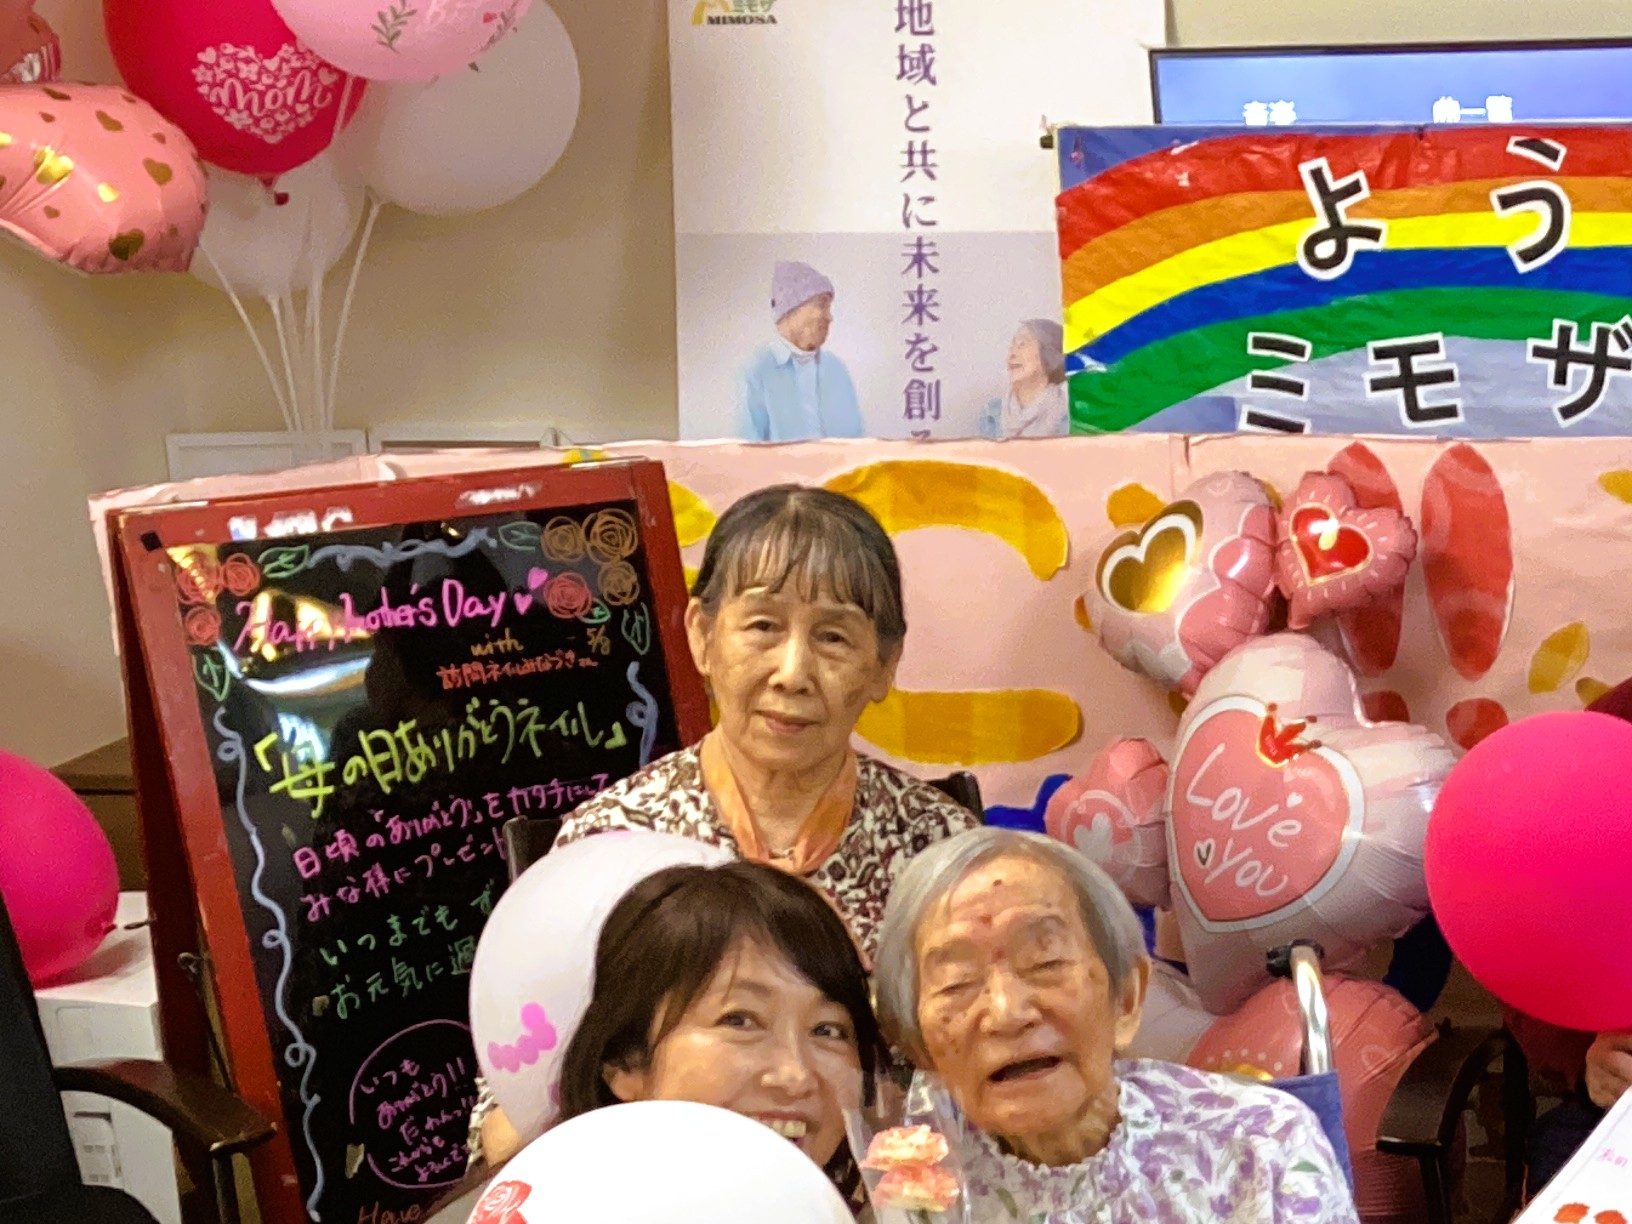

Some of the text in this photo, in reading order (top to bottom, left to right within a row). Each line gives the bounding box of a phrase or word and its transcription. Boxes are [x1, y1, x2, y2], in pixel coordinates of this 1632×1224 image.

[707, 15, 778, 25] MIMOSA
[894, 0, 942, 440] 地域と共に未来を創
[441, 578, 507, 628] Day
[470, 627, 524, 657] with
[1186, 742, 1306, 850] Love
